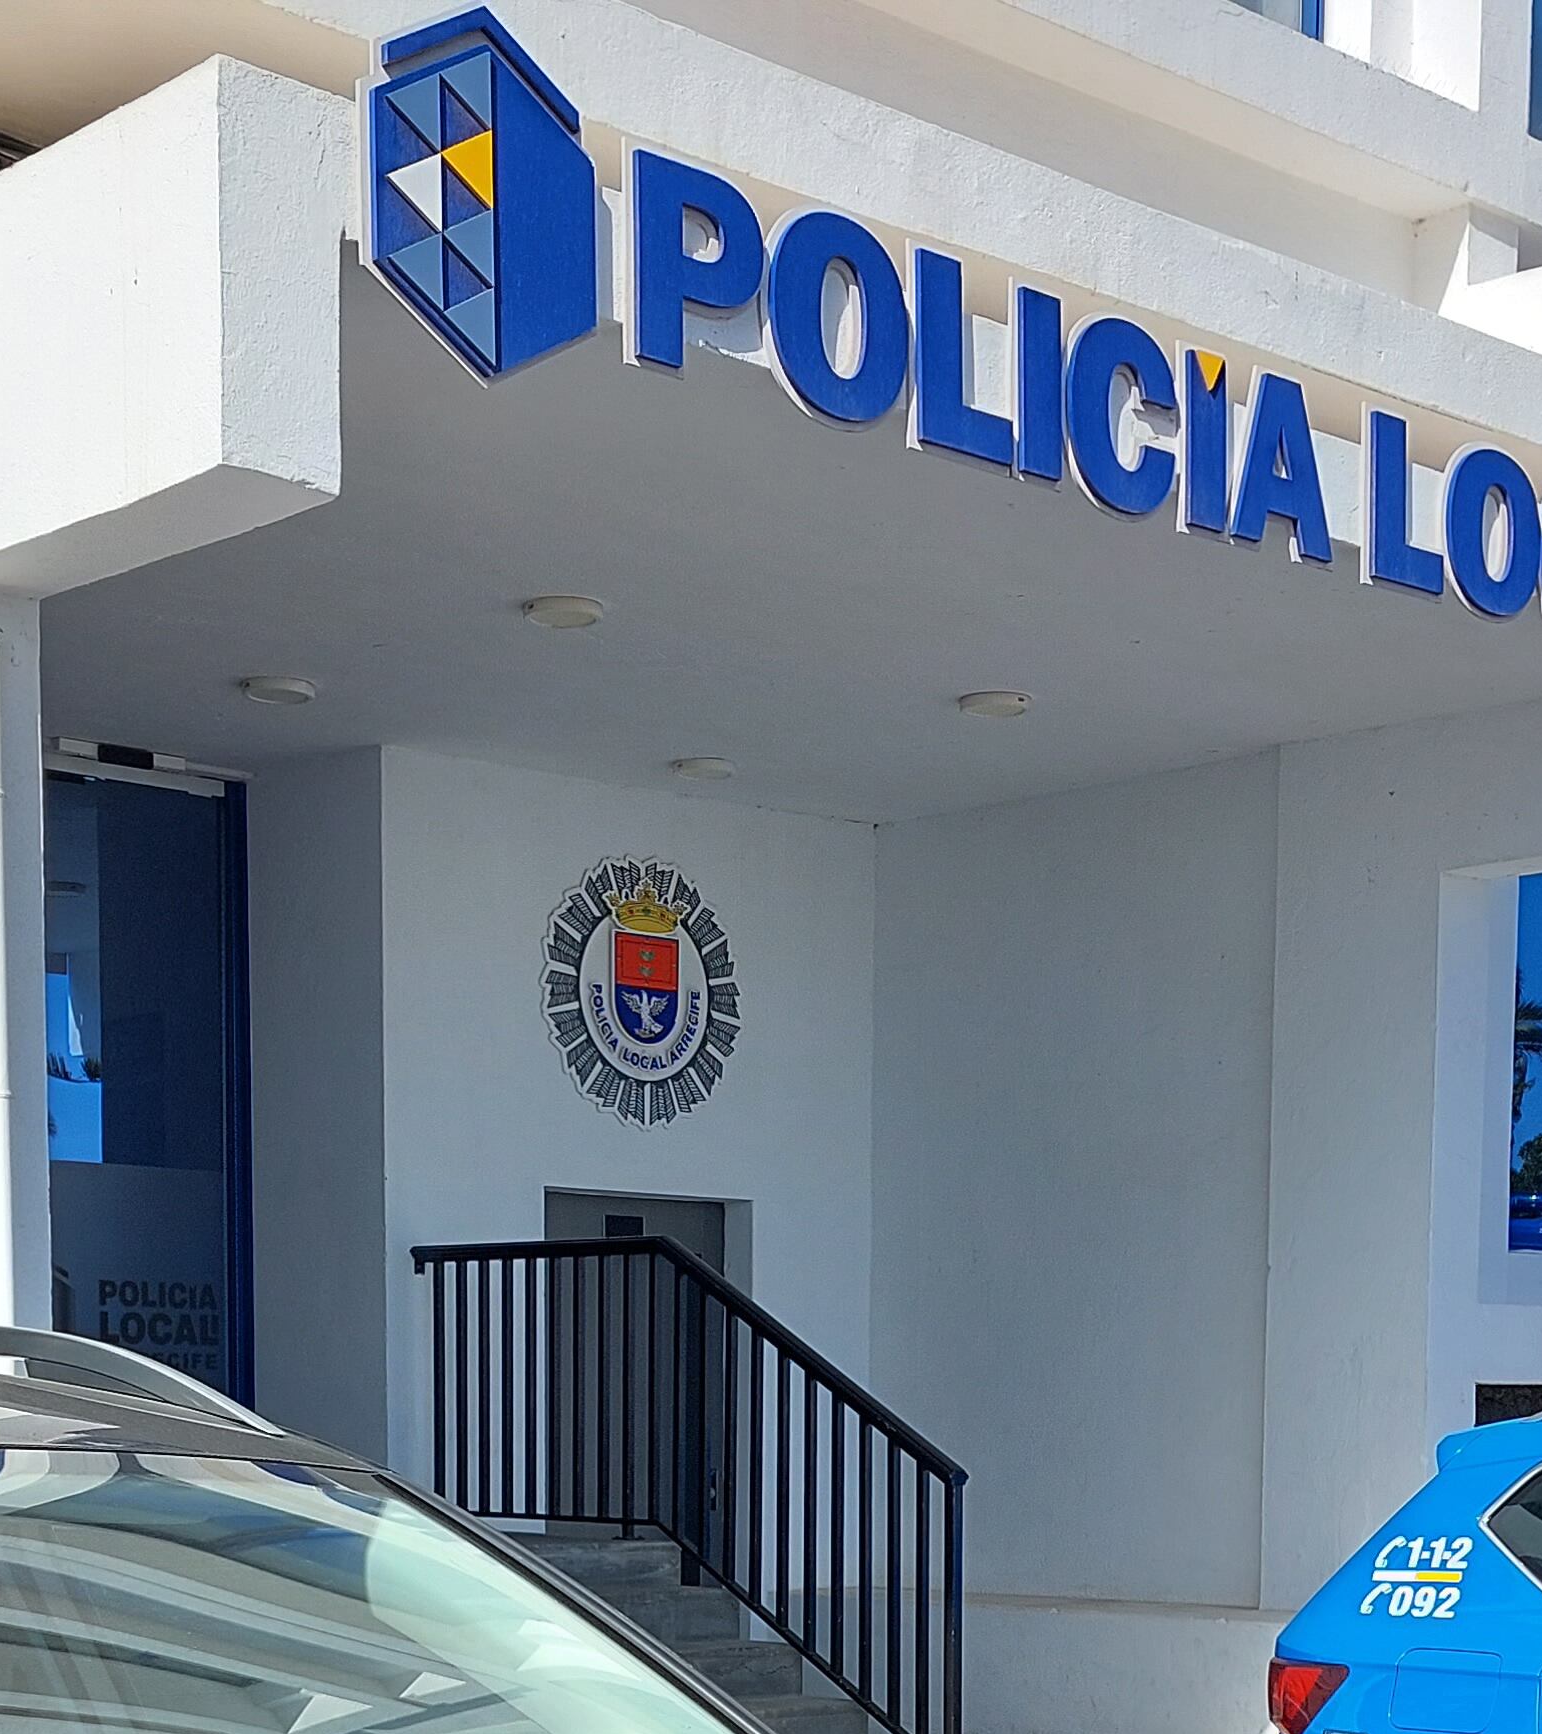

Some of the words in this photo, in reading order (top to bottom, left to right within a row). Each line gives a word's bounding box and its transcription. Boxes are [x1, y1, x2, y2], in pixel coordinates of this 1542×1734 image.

[622, 1047, 668, 1071] LOCAL
[669, 990, 701, 1066] ARRECIFE
[99, 1311, 220, 1346] LOCAL
[1387, 1585, 1462, 1619] 092
